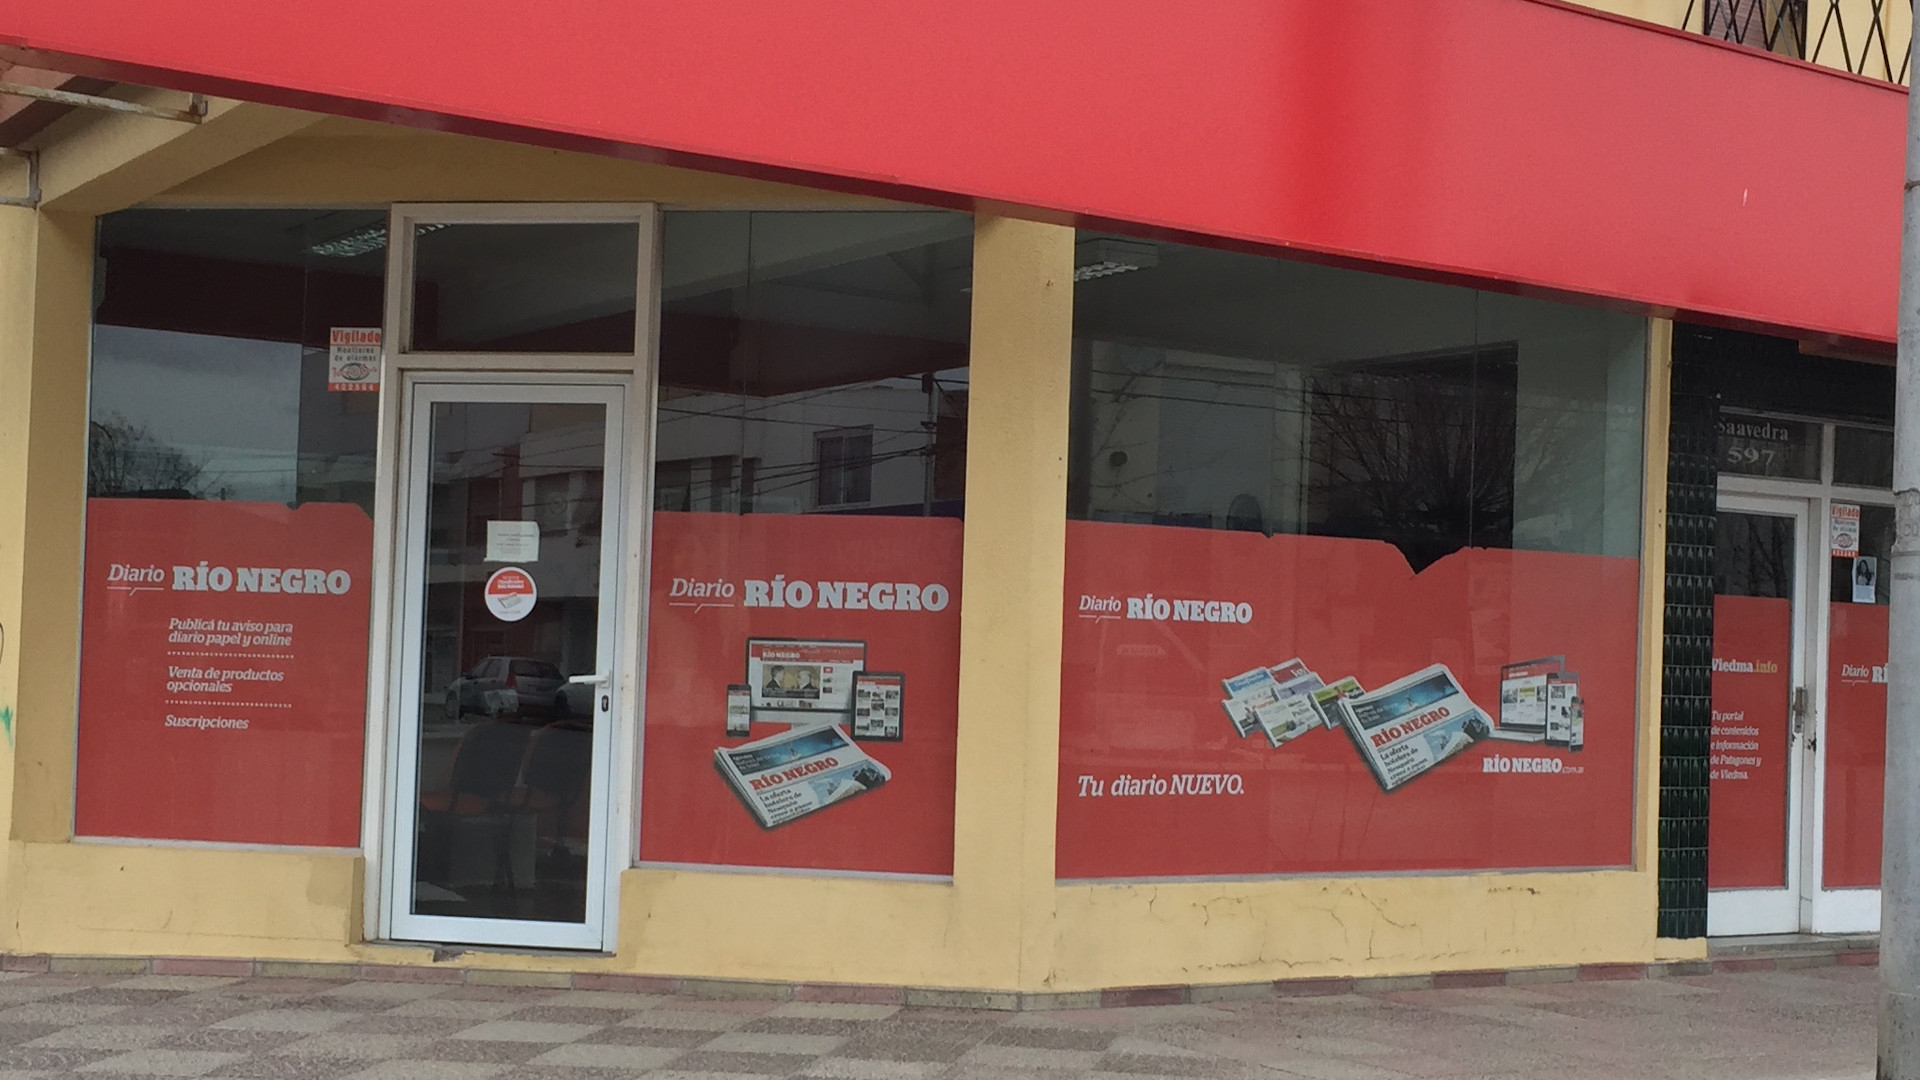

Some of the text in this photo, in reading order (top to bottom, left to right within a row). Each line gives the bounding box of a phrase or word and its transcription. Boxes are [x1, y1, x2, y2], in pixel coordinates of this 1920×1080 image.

[332, 330, 381, 345] Vigilado
[1718, 421, 1788, 440] Saavedra
[1727, 446, 1776, 466] 597
[107, 561, 351, 595] Diario RÍO NEGRO
[669, 574, 949, 612] Diario RÍO NEGRO
[1079, 593, 1253, 623] Diario RÍO NEGRO
[169, 618, 293, 634] Publicá tu aviso para
[168, 631, 292, 647] diario papel y online
[168, 666, 284, 681] Venta de productos
[1711, 658, 1778, 673] Viedma.info
[1841, 662, 1888, 683] Diario RÍ
[166, 680, 233, 693] opcionales
[165, 714, 250, 730] Suscripciones
[1712, 710, 1744, 722] Tu portal
[1370, 728, 1402, 747] RÍO
[1399, 706, 1450, 735] NEGRO
[1711, 726, 1759, 736] de contenidos
[1716, 740, 1759, 751] información
[1482, 754, 1511, 773] RÍO
[1710, 755, 1762, 767] de Patagones y
[749, 774, 784, 790] RÍO
[781, 757, 839, 780] NEGRO
[1709, 770, 1719, 779] de
[1078, 774, 1244, 797] Tu diario NUEVO.
